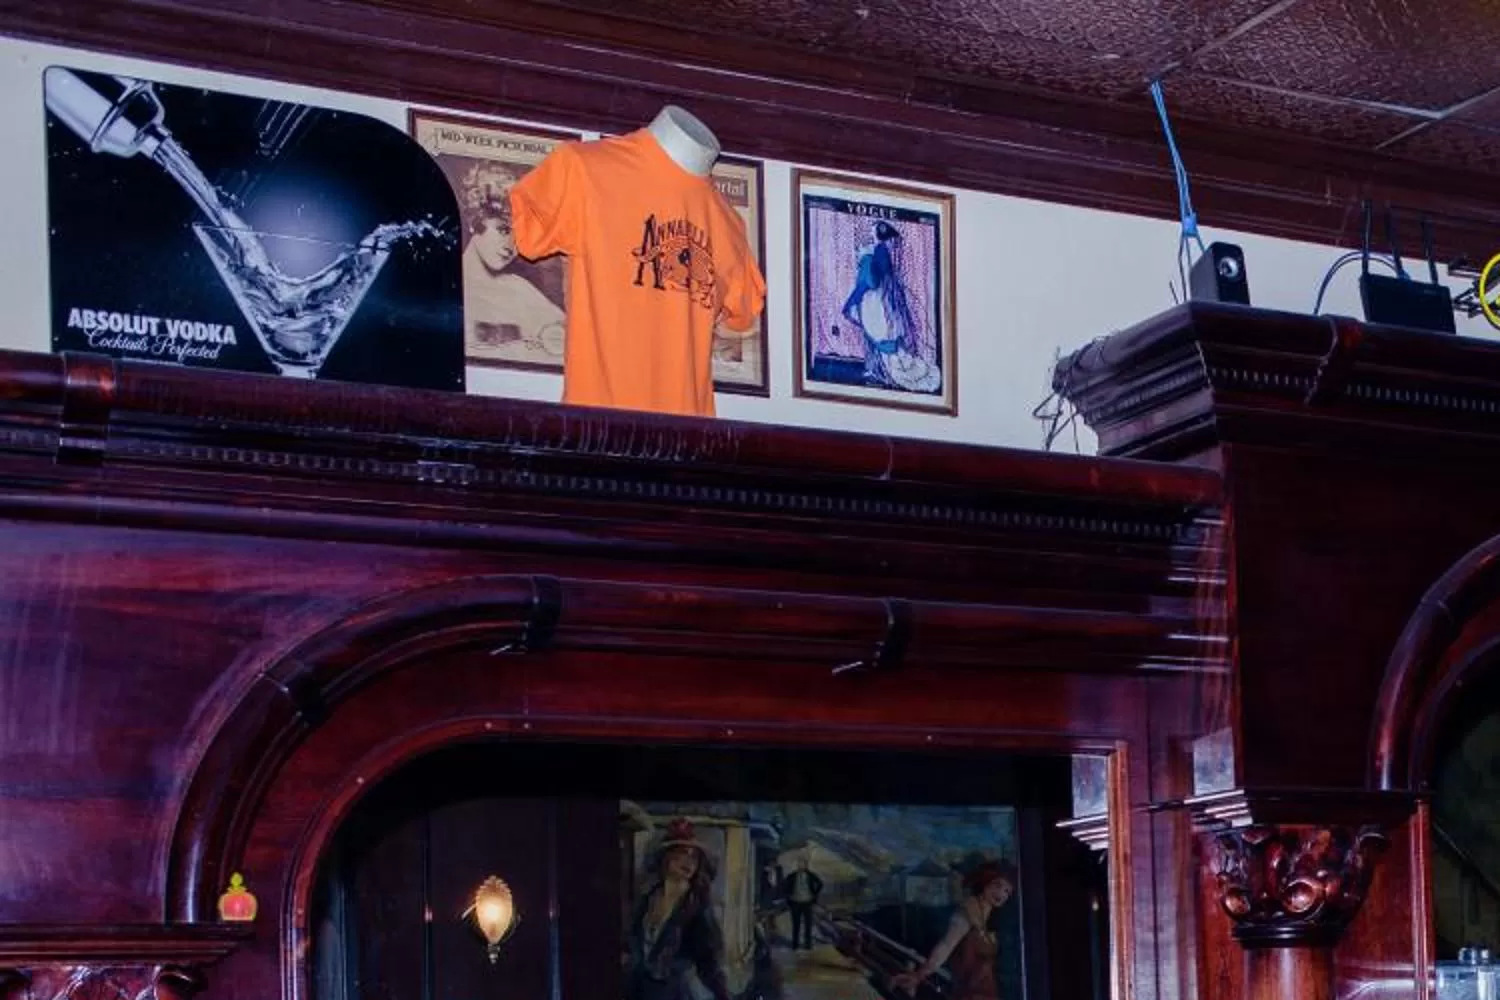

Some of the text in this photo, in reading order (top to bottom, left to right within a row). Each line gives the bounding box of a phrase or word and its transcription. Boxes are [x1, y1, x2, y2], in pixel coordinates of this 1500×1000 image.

[847, 202, 897, 219] VOGUE
[67, 307, 237, 345] ABSOLUT VODKA
[83, 327, 222, 362] Cocktails Perfected
